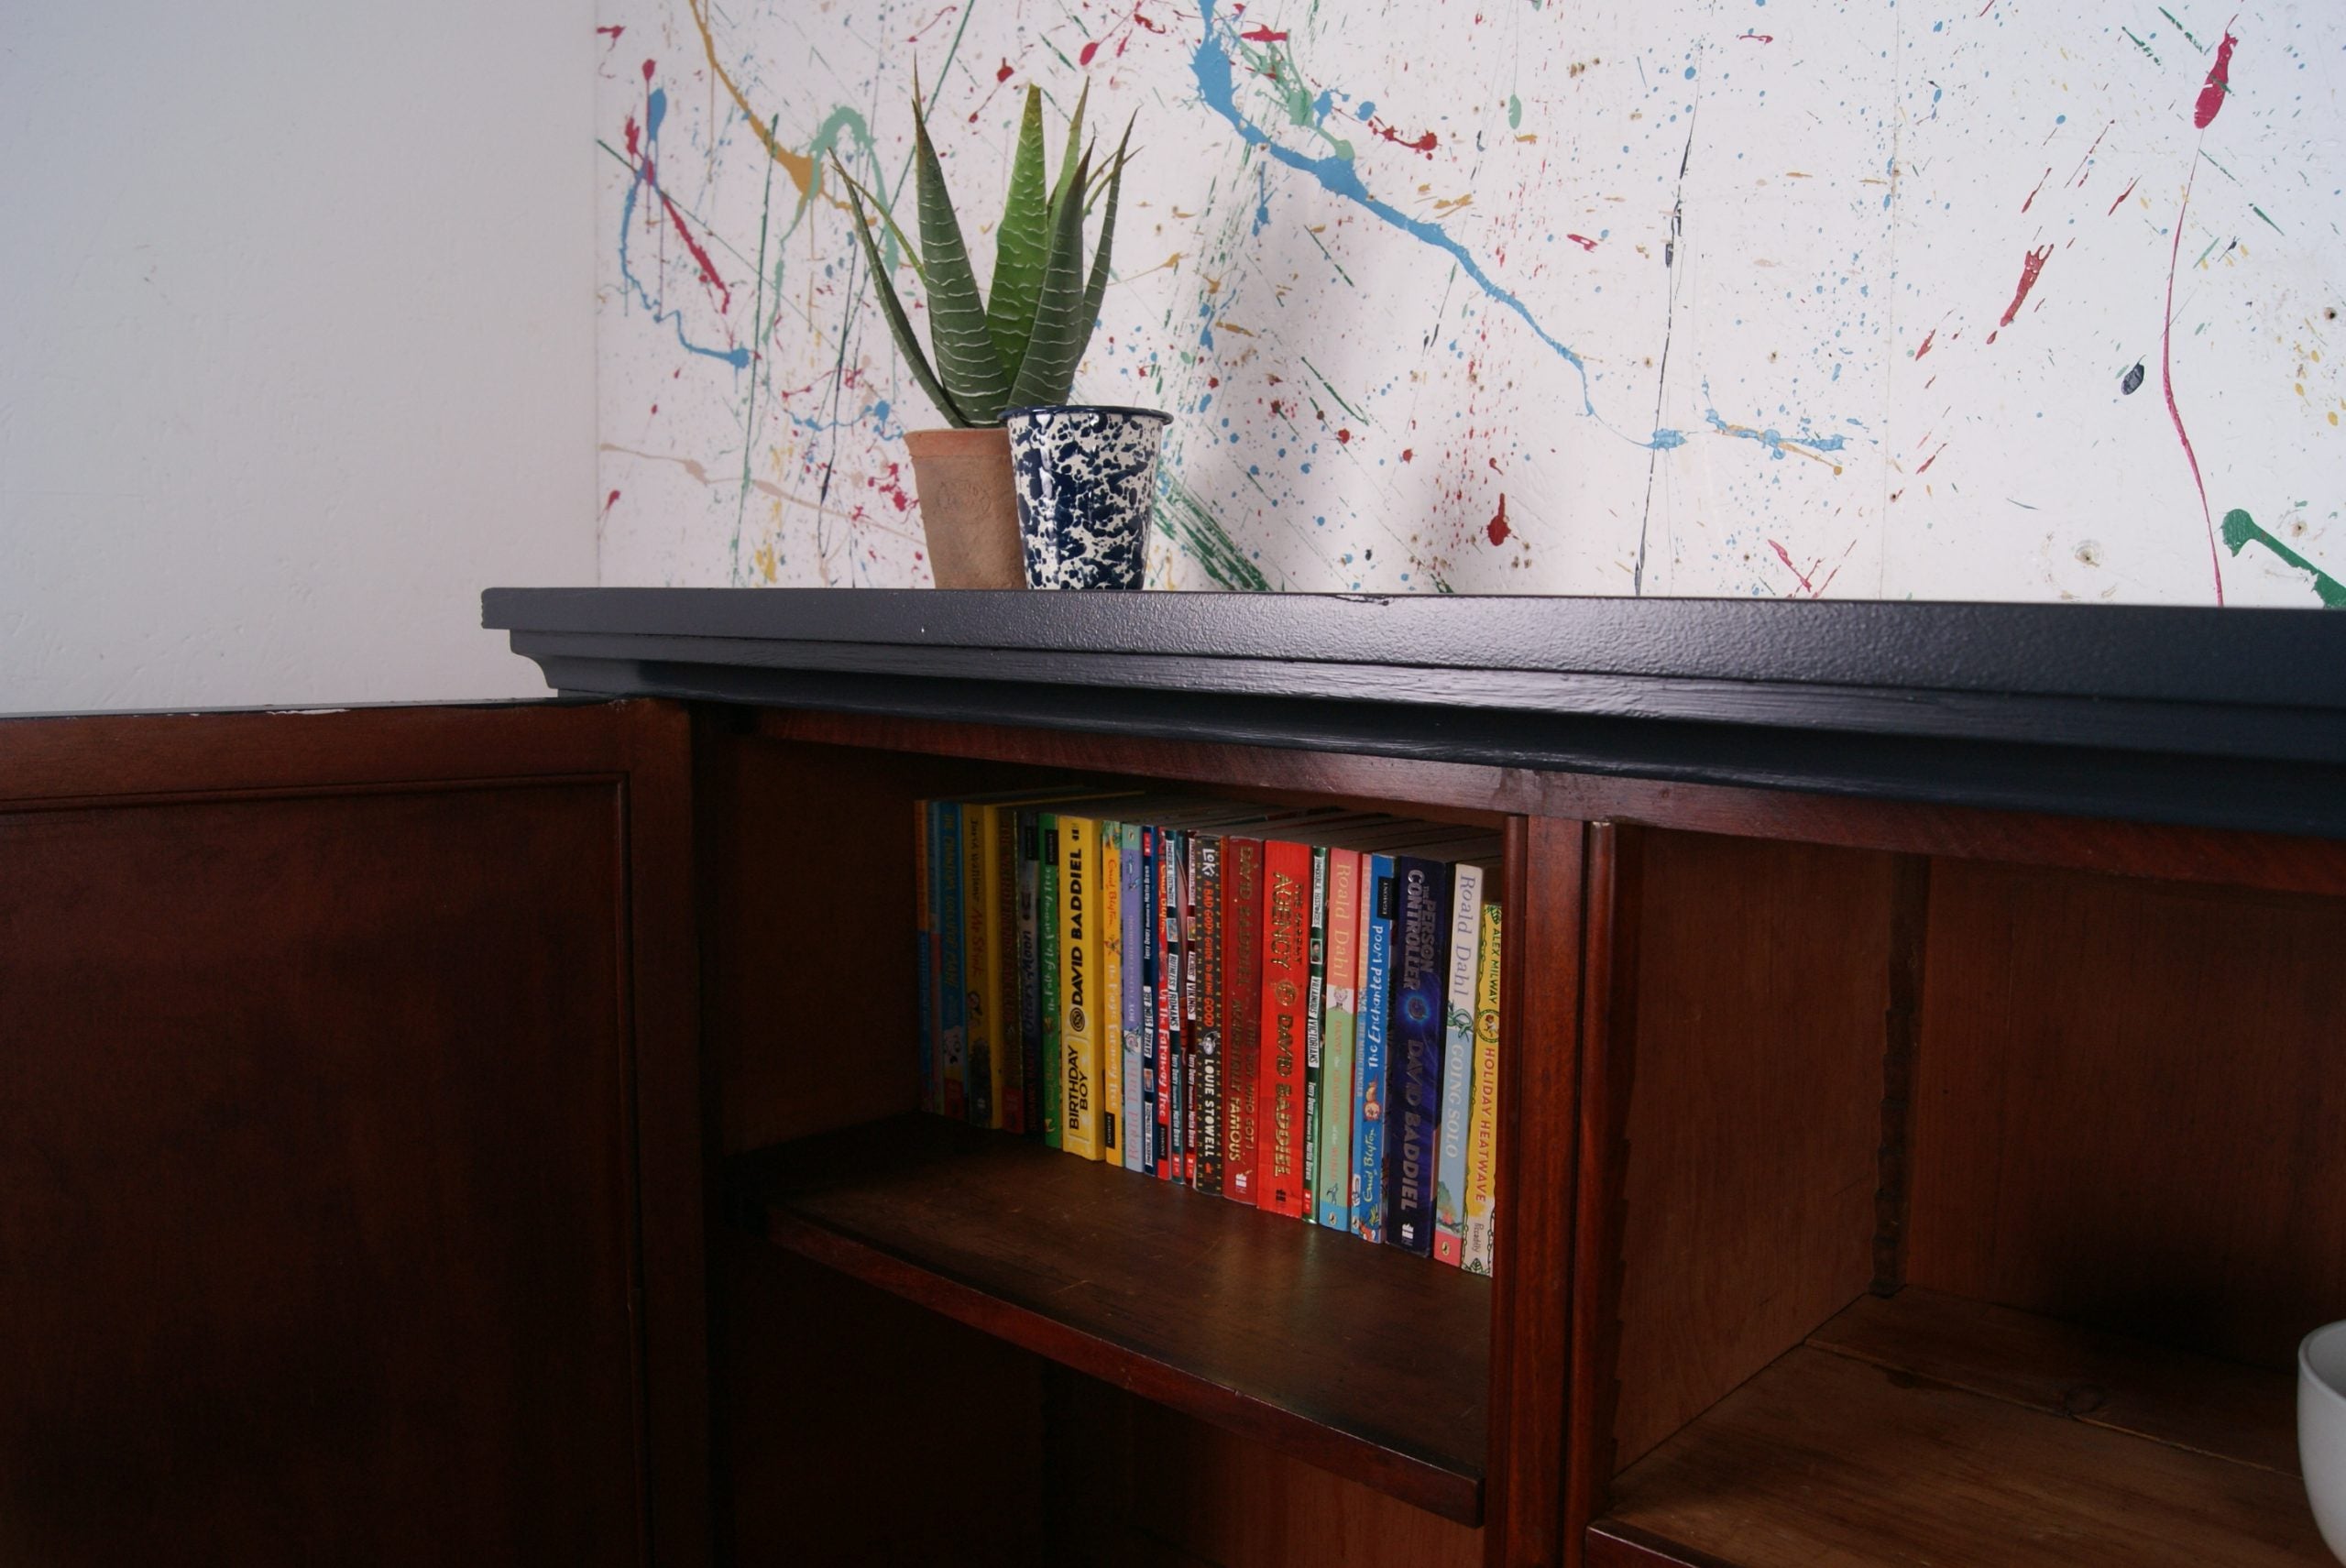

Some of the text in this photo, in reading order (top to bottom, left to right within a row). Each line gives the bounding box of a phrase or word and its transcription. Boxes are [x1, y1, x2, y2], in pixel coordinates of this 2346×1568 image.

[1043, 866, 1053, 893] Tree
[1106, 859, 1118, 927] Enid Blyton
[1202, 888, 1214, 908] BAD
[1294, 883, 1303, 907] THE
[1313, 858, 1322, 927] HORRIBLE HISTORIES
[1069, 849, 1083, 1006] DAVID BADDIEL
[1203, 937, 1214, 960] GUIDE
[1237, 846, 1254, 987] DAVID BADDIEL
[1271, 872, 1293, 970] AGENCY
[1333, 863, 1352, 979] Roald Dahl
[1404, 870, 1426, 991] CONTROLLER
[1421, 898, 1438, 972] PERSON
[1453, 875, 1476, 996] Roald Dahl
[971, 937, 985, 978] Stink
[1022, 930, 1035, 979] Moon
[1044, 972, 1053, 996] Folk
[1047, 959, 1057, 971] of
[1488, 927, 1502, 1005] ALEX MILWAY
[1107, 982, 1118, 1020] Magic
[1168, 955, 1179, 1028] RUTHLESS ROMANS
[1188, 984, 1196, 1015] VIKINGS
[1203, 996, 1214, 1027] GOOD
[1308, 978, 1321, 1064] VILLAINOUS VICTORIANS
[1367, 926, 1384, 1069] The Enchanted Wood
[1108, 1023, 1120, 1080] Faraway
[1158, 989, 1169, 1118] Up The Faraway Tree
[1203, 1058, 1215, 1096] LOUIE
[1356, 1067, 1365, 1098] FINGER
[1357, 1040, 1365, 1065] MAGIC
[1068, 1045, 1080, 1130] BIRTHDAY
[1080, 1070, 1089, 1111] BOY
[1109, 1082, 1119, 1109] Tree
[1245, 1083, 1255, 1114] WHO
[1275, 1014, 1293, 1179] DAVID BADDIEL
[1446, 1043, 1464, 1158] GOING SOLO
[1126, 1111, 1139, 1161] Roald
[1203, 1100, 1215, 1157] STOWELL
[1228, 1096, 1242, 1162] FAMOUS
[1400, 1038, 1424, 1212] DAVID BADDIEL
[1474, 1047, 1496, 1203] HOLIDAY HEATWAVE
[1363, 1128, 1376, 1202] Enid Blyton
